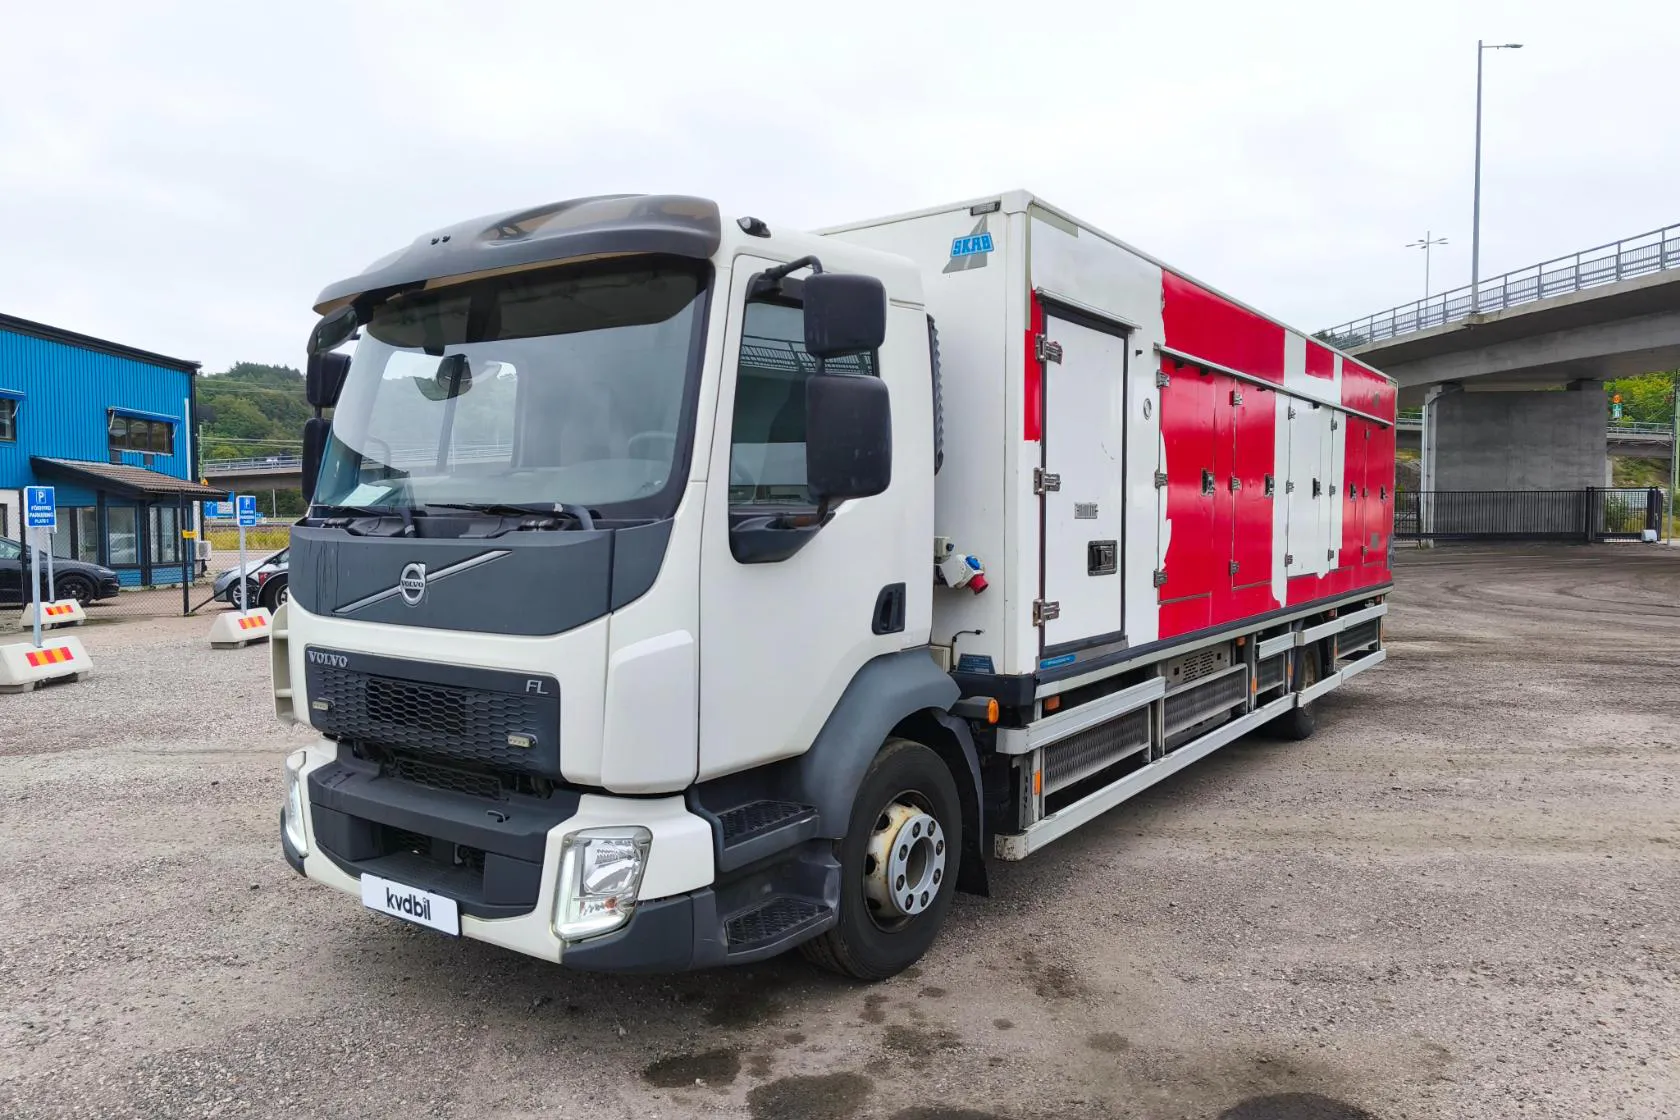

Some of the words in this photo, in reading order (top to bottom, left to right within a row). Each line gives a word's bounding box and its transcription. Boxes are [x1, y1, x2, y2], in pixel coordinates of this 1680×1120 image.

[953, 235, 991, 256] SKAB
[38, 491, 44, 503] P
[401, 580, 424, 588] VOLVO
[307, 650, 348, 668] VOLVO
[525, 679, 550, 695] FL
[386, 887, 431, 921] kvdbil
